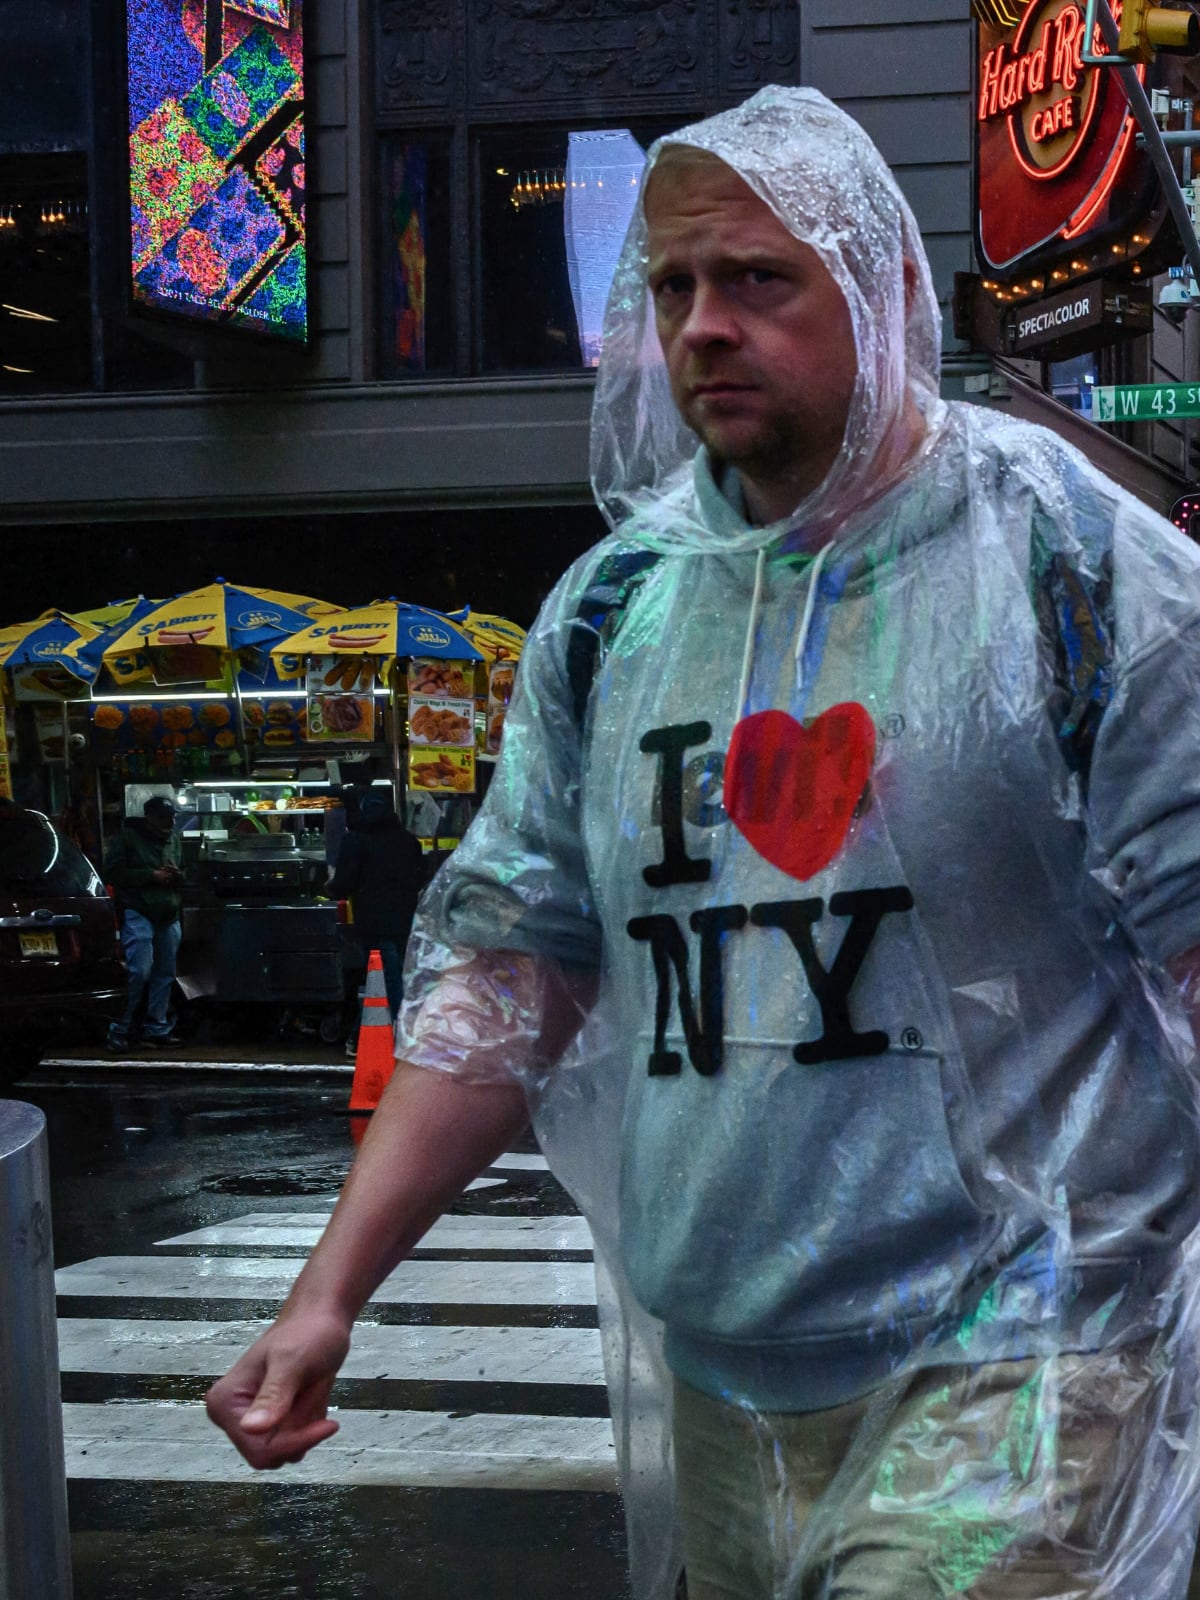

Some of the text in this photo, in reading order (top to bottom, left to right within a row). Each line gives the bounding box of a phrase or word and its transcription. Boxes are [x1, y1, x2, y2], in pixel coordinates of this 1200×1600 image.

[978, 22, 1051, 121] Hard
[1030, 96, 1074, 142] CAFE
[1019, 298, 1090, 338] SPECTACOLOR
[1121, 391, 1139, 416] W
[1151, 388, 1177, 415] 43
[137, 613, 218, 636] SABRETT
[308, 622, 391, 638] SABRETT
[639, 720, 712, 888] I
